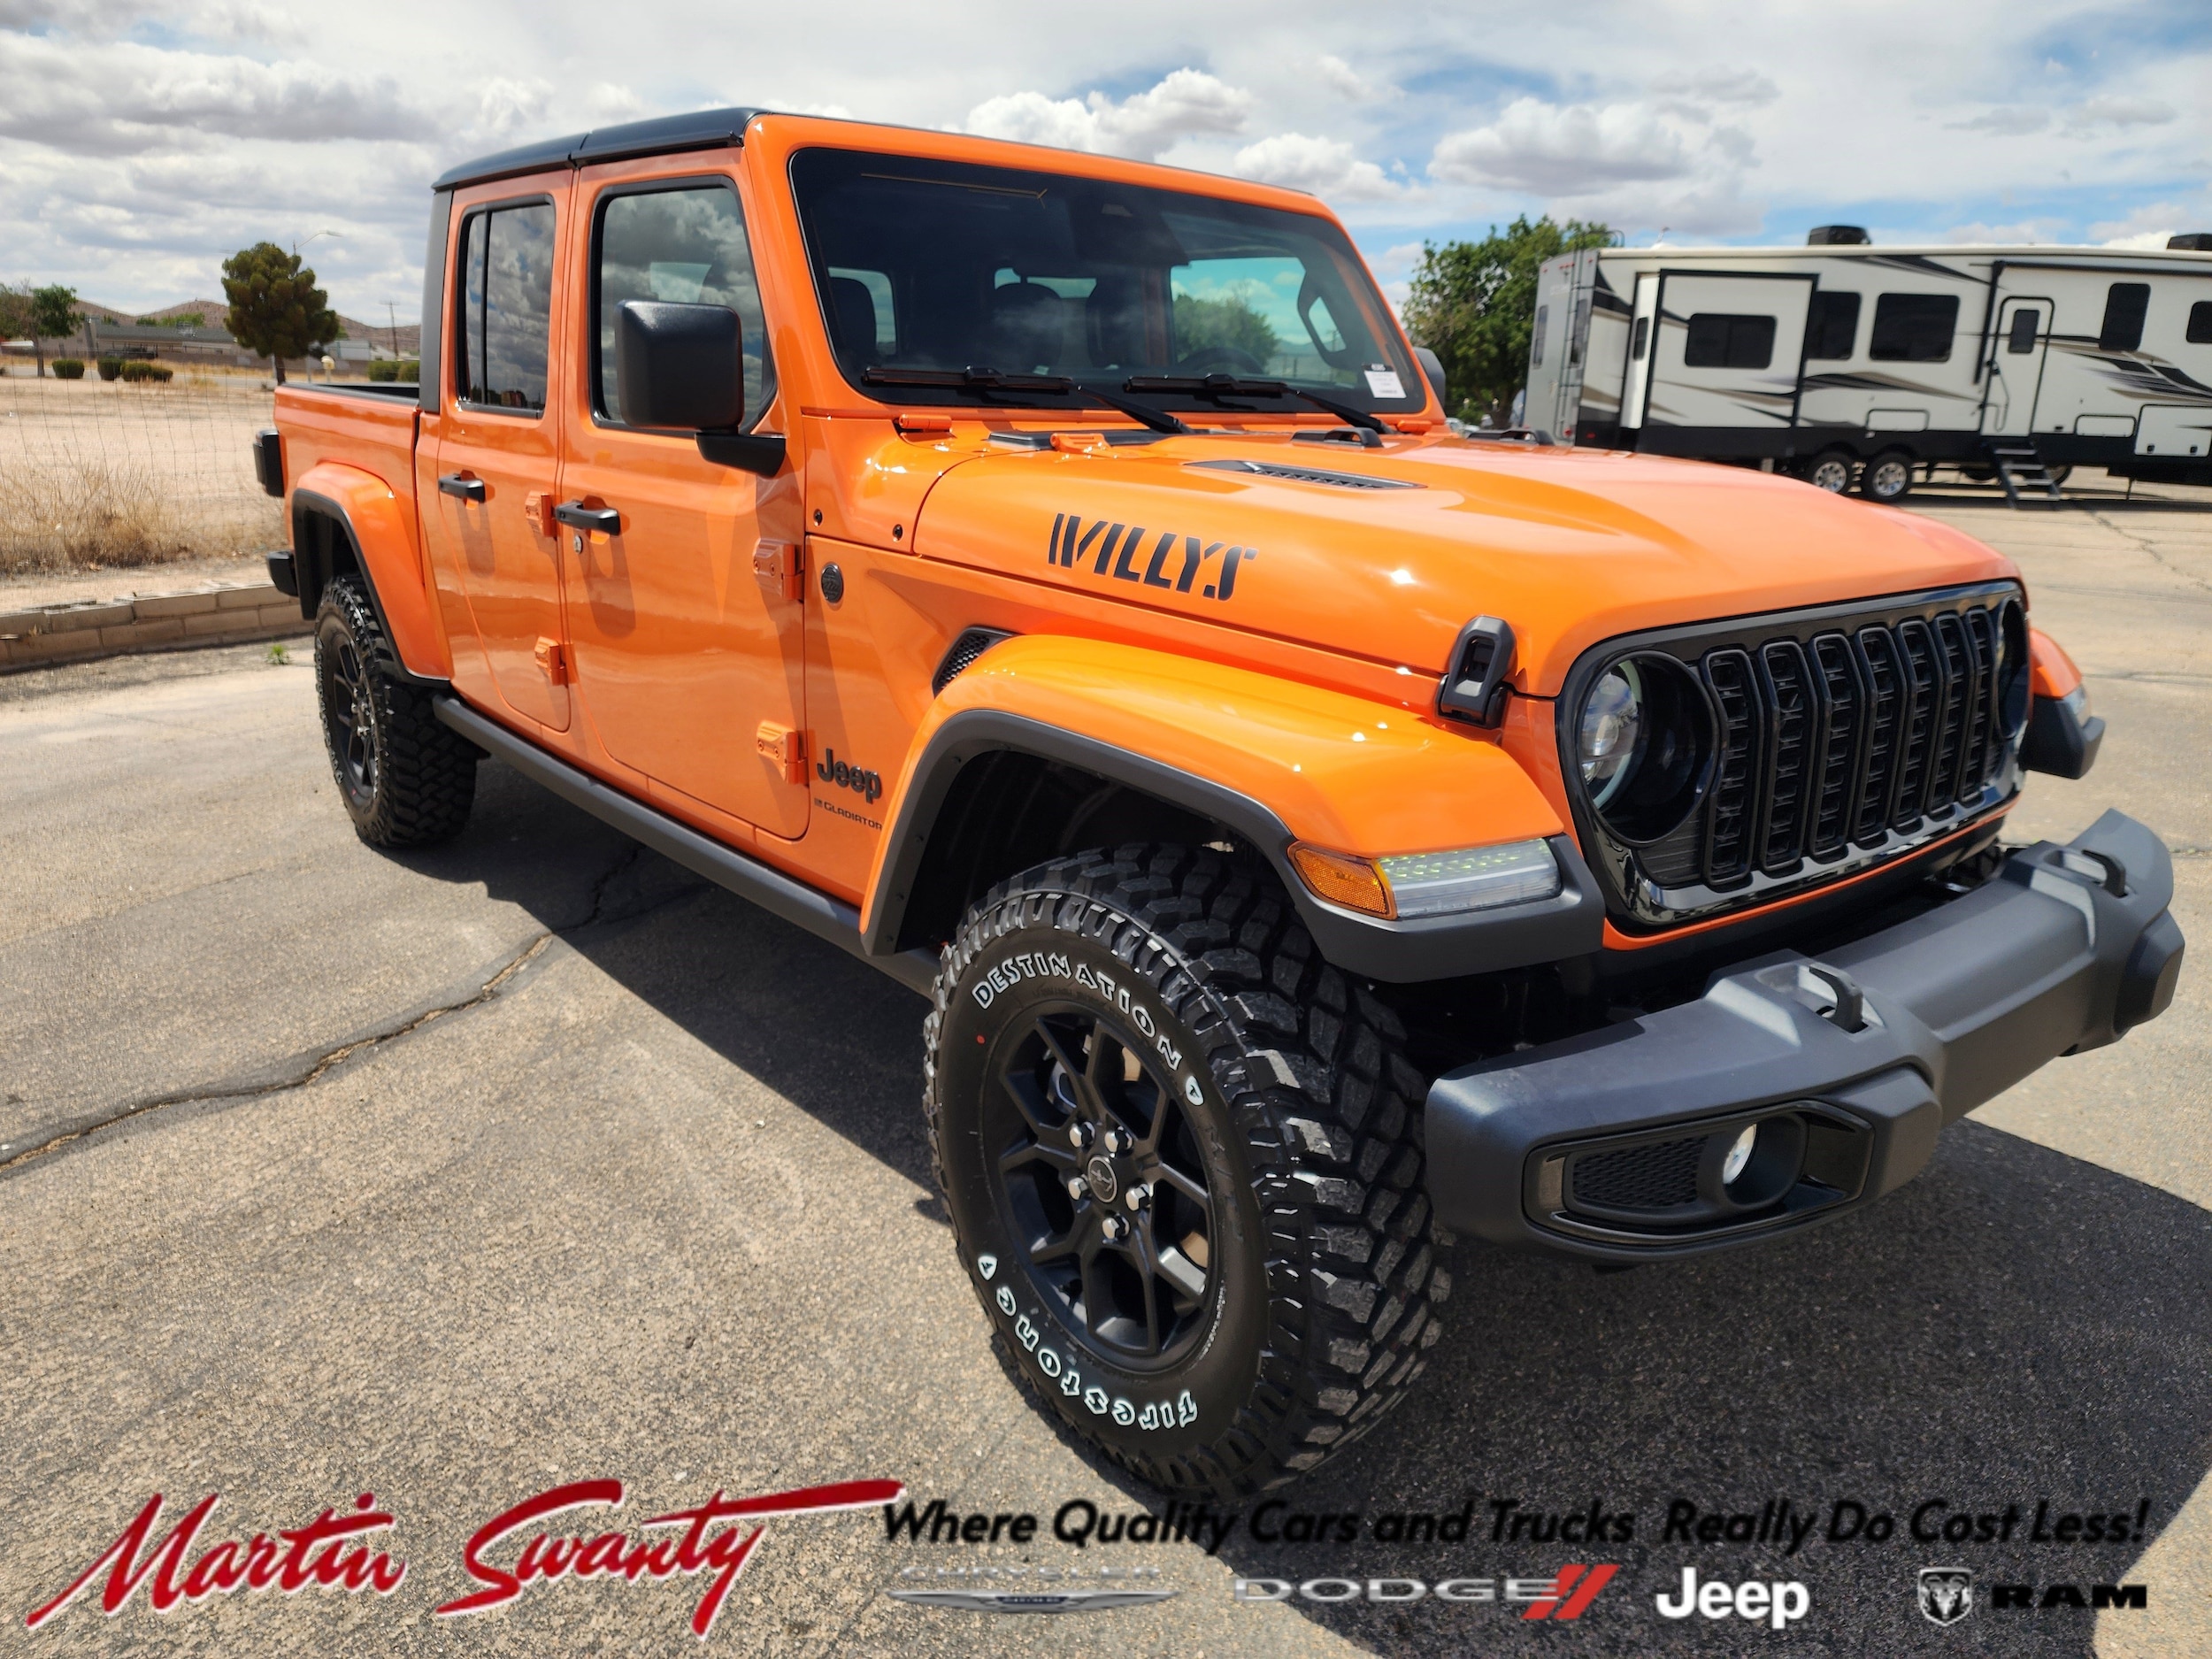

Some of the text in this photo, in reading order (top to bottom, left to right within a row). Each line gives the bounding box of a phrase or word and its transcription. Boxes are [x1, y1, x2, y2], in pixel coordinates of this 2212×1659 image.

[1048, 512, 1258, 602] WILLYS
[817, 748, 882, 805] Jeep
[824, 800, 883, 831] GLADIATOR
[972, 951, 1183, 1071] DESTINATION
